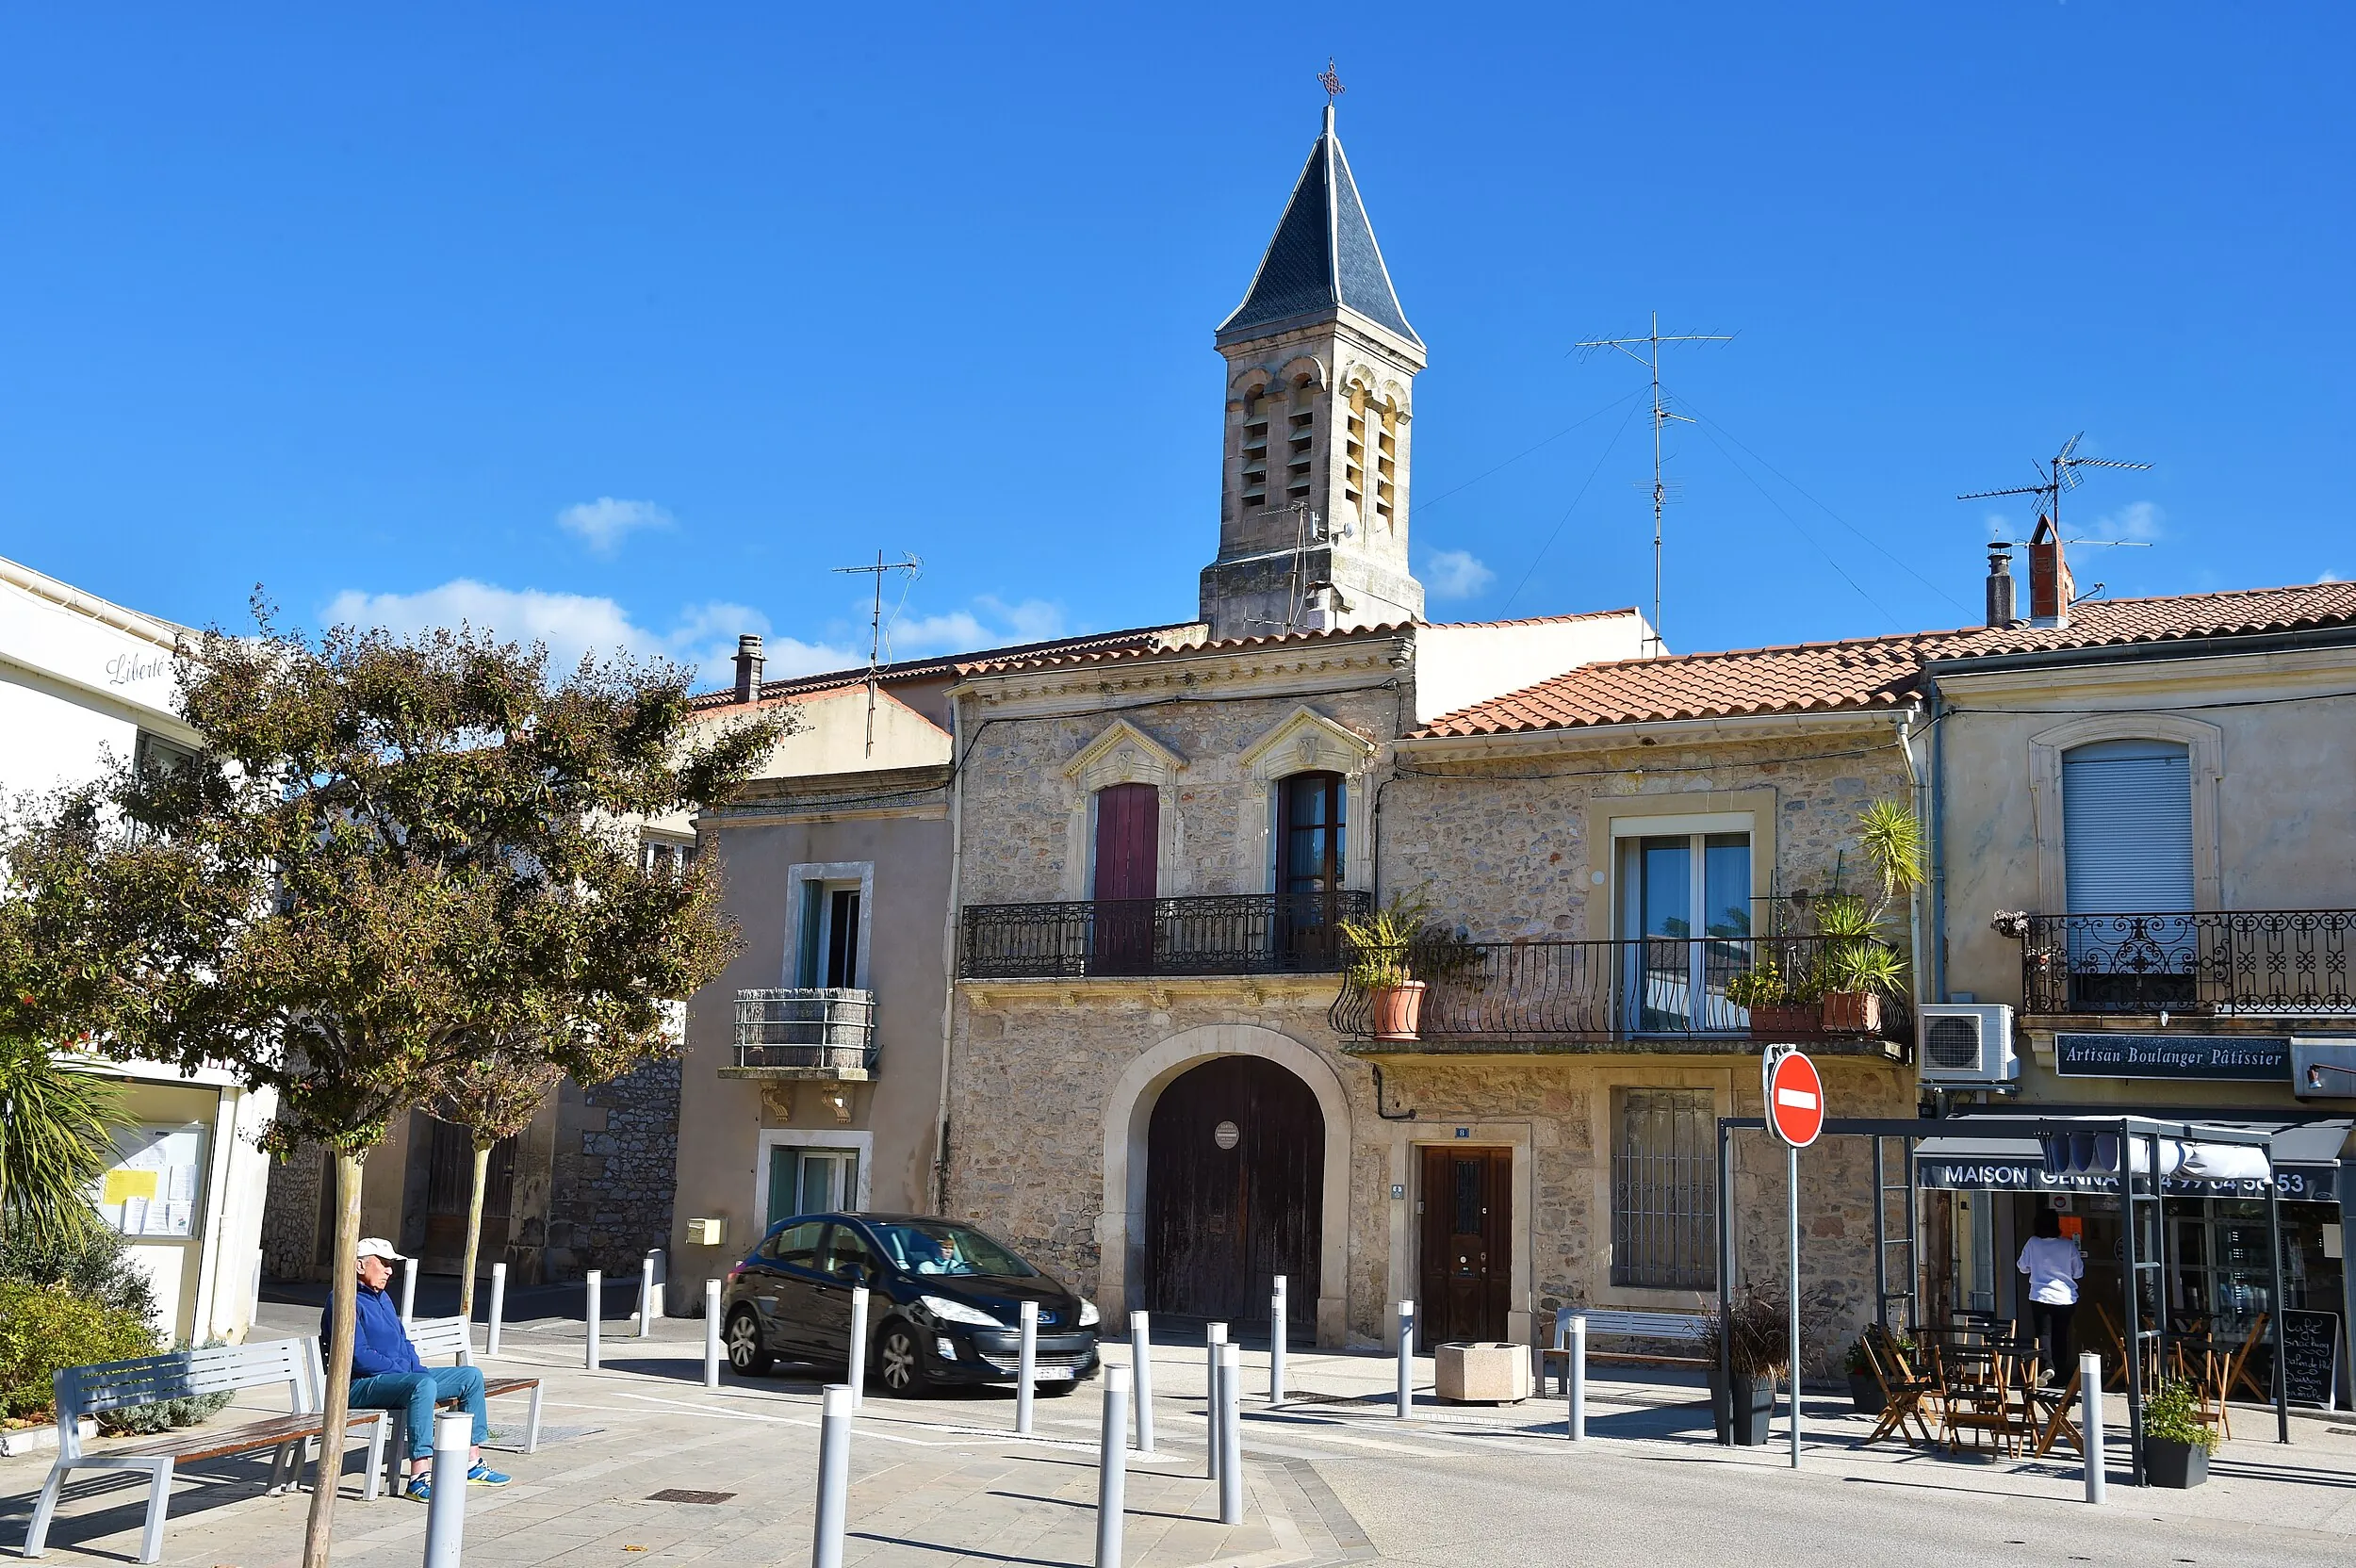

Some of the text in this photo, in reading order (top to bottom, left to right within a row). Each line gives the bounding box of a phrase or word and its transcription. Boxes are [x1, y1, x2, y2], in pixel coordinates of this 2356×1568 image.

[106, 652, 165, 685] Liberté
[2066, 1046, 2282, 1068] Artisan Boulanger Pâtissier
[1945, 1166, 2028, 1184] MAISON
[2276, 1173, 2304, 1192] 53
[2285, 1318, 2323, 1341] Café
